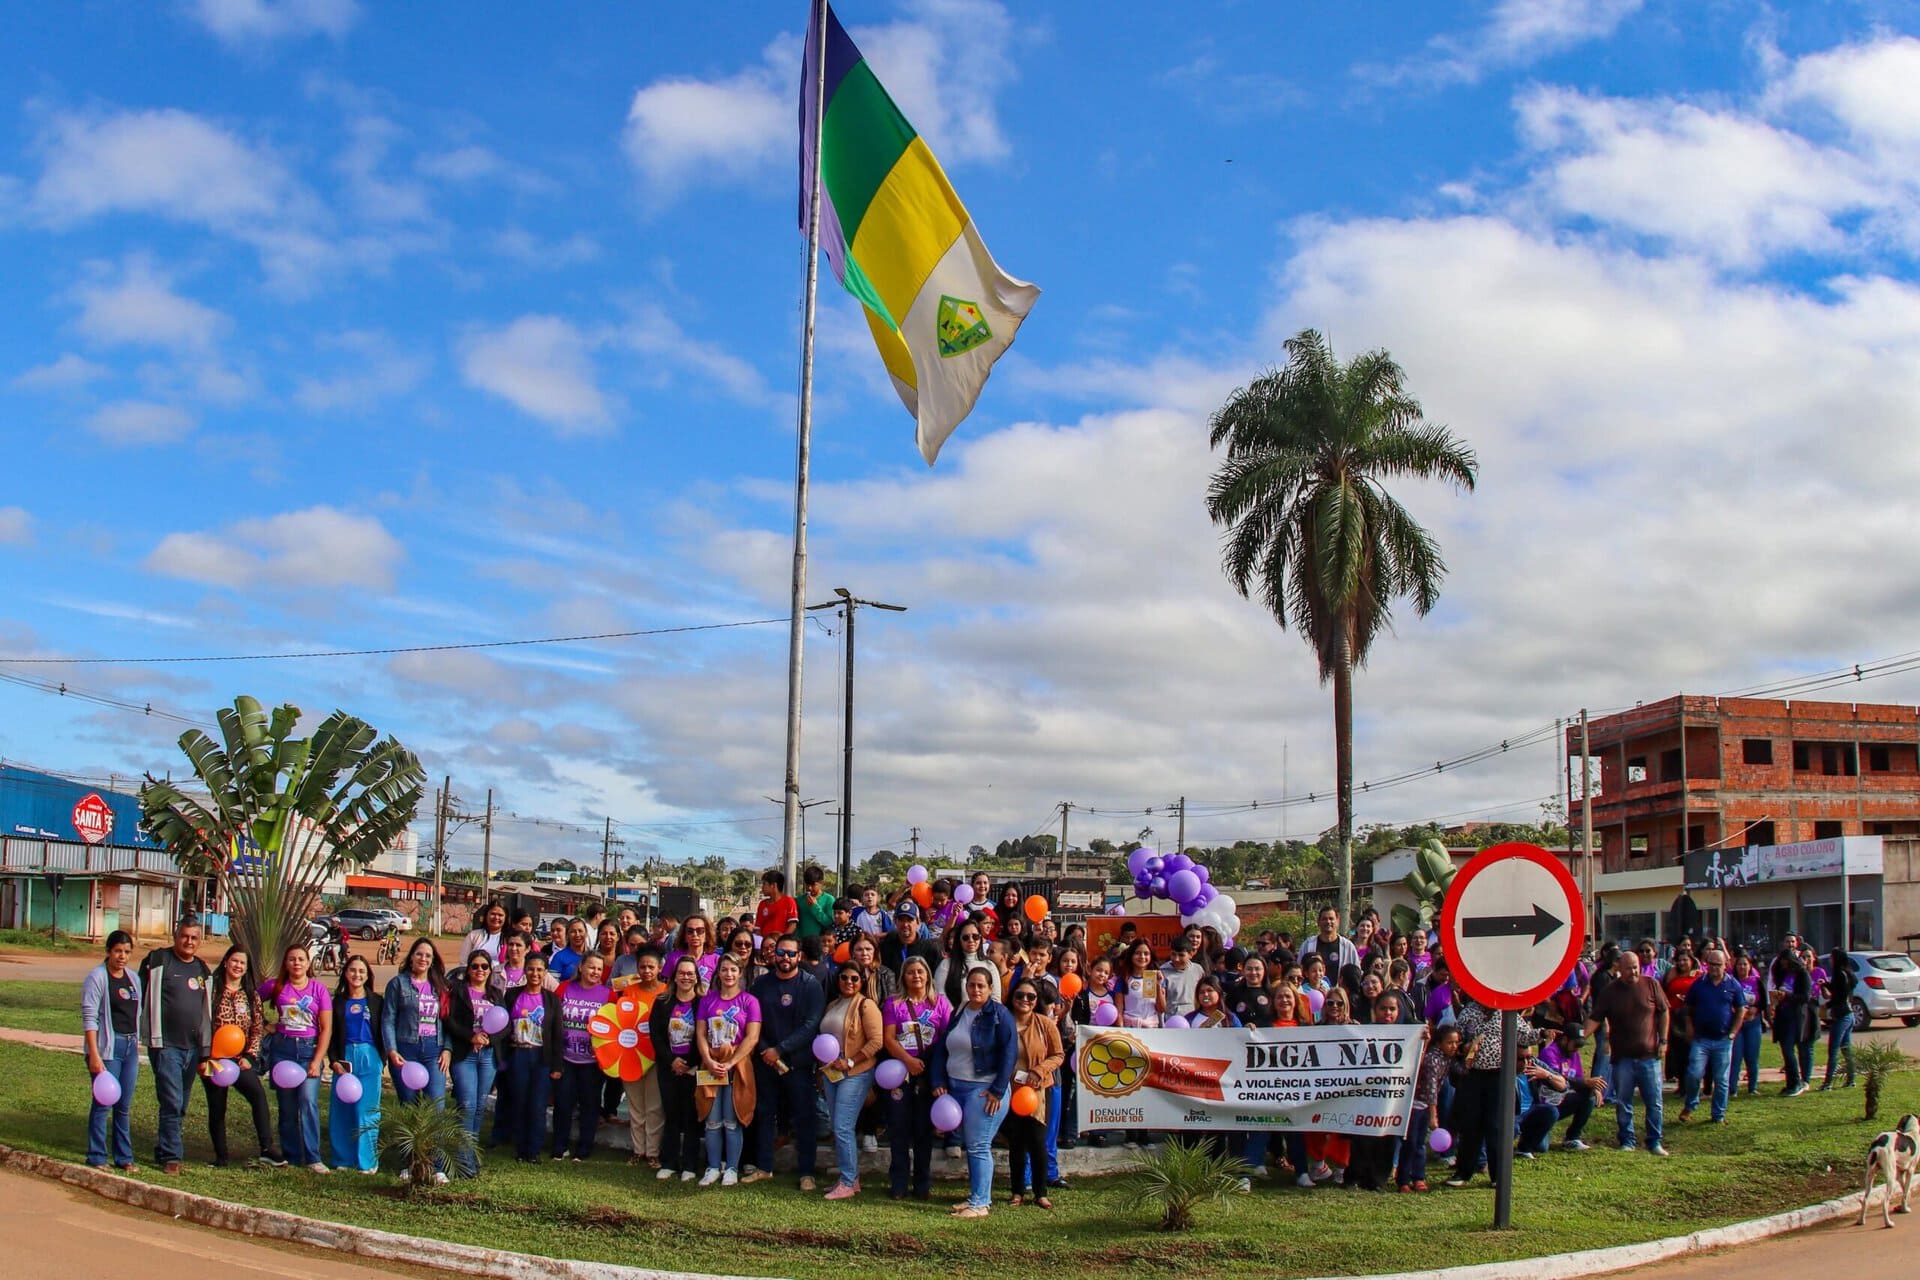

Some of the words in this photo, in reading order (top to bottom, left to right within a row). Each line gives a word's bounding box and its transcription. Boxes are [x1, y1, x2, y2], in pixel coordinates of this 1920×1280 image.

[75, 807, 102, 829] SANTA
[1775, 845, 1799, 858] AGRO
[1245, 1044, 1321, 1069] DIGA
[1338, 1038, 1403, 1067] NÃO
[1158, 1056, 1181, 1075] 18
[1233, 1079, 1243, 1089] A
[1245, 1077, 1311, 1089] VIOLÊNCIA
[1314, 1077, 1362, 1088] SEXUAL
[1365, 1076, 1411, 1086] CONTRA
[1238, 1091, 1300, 1102] CRIANÇAS
[1303, 1091, 1312, 1101] E
[1314, 1088, 1405, 1101] ADOLESCENTES
[1094, 1107, 1144, 1116] DENUNCIE
[1094, 1115, 1127, 1123] DISQUE
[1183, 1115, 1212, 1123] MPAC
